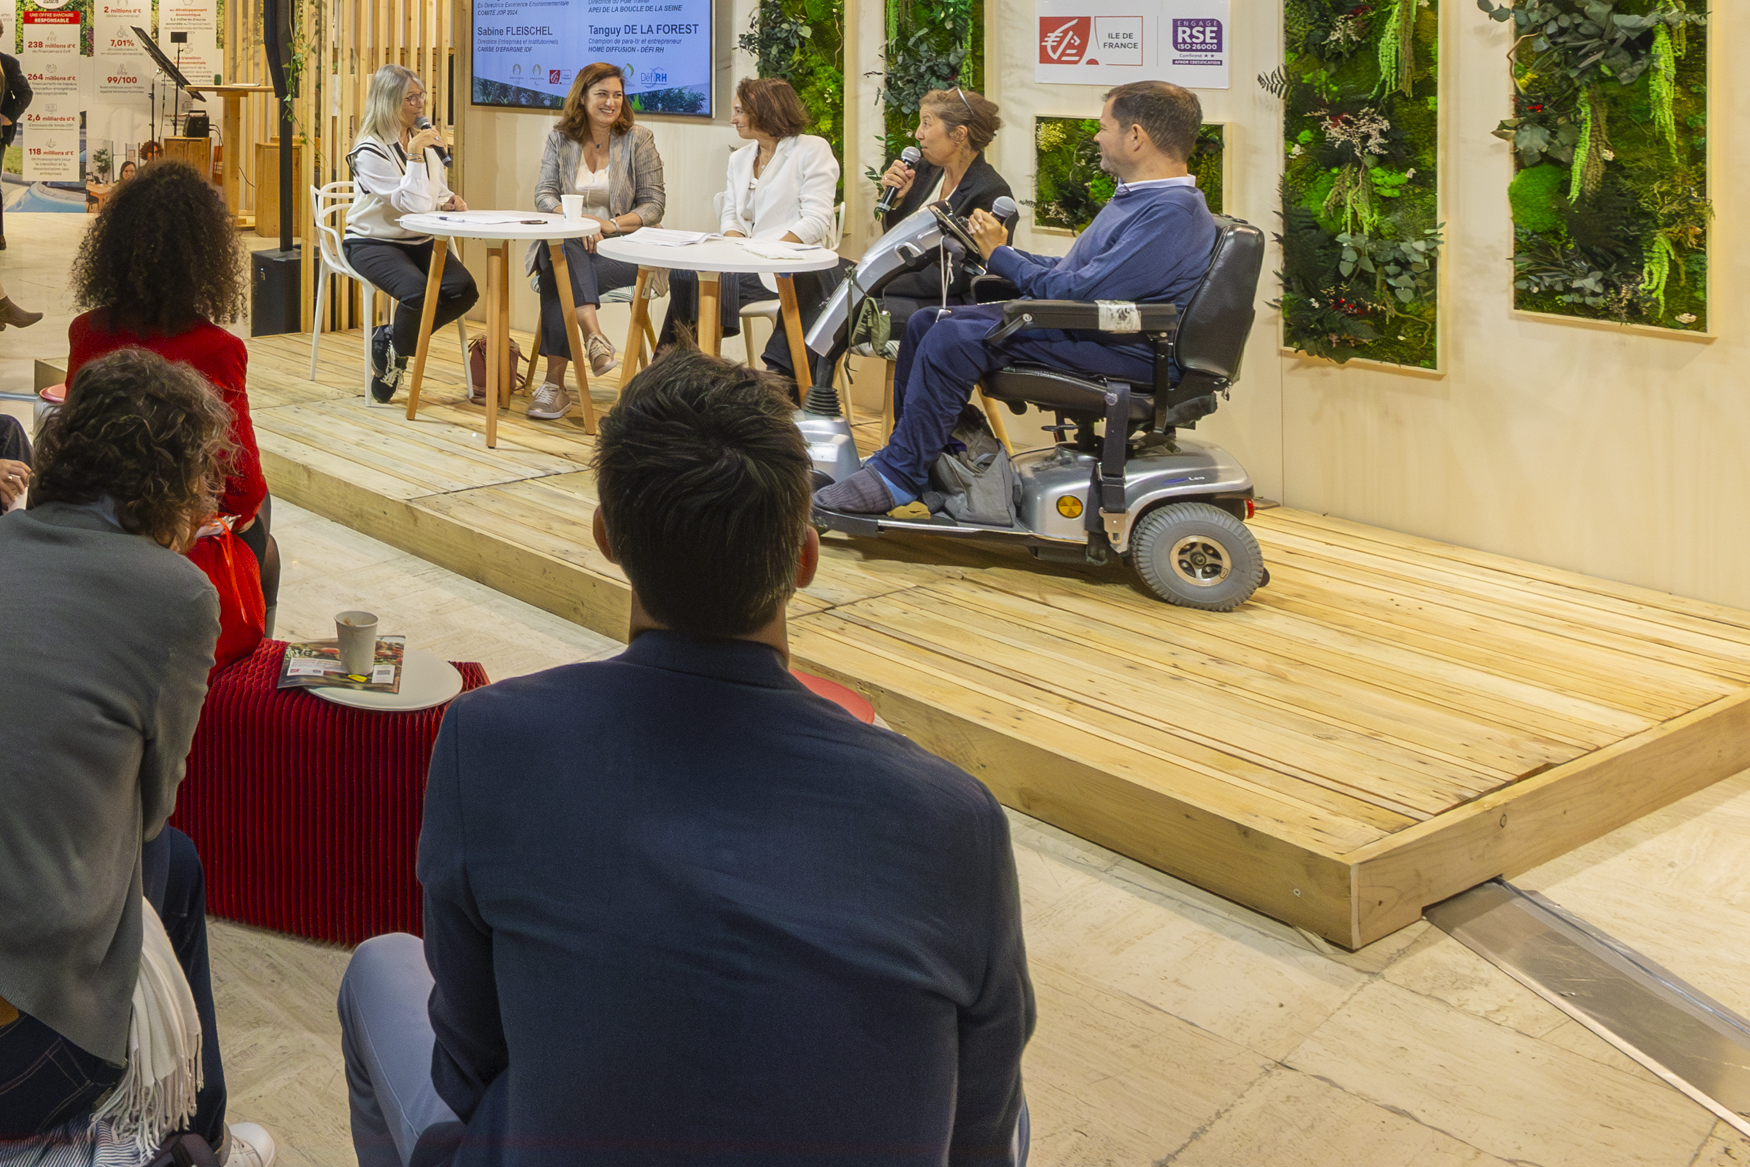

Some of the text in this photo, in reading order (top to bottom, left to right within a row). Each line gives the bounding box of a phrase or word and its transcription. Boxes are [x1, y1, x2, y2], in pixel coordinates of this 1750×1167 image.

[664, 4, 682, 12] SEINE
[477, 26, 553, 36] Sabine FLEISCHEL
[588, 23, 699, 37] Tanguy DE LA FOREST
[1177, 26, 1218, 43] RSE
[110, 39, 135, 47] 7,01%
[588, 37, 613, 45] Champion
[28, 73, 43, 81] 264
[107, 76, 138, 84] 99/100
[27, 114, 41, 122] 2,6
